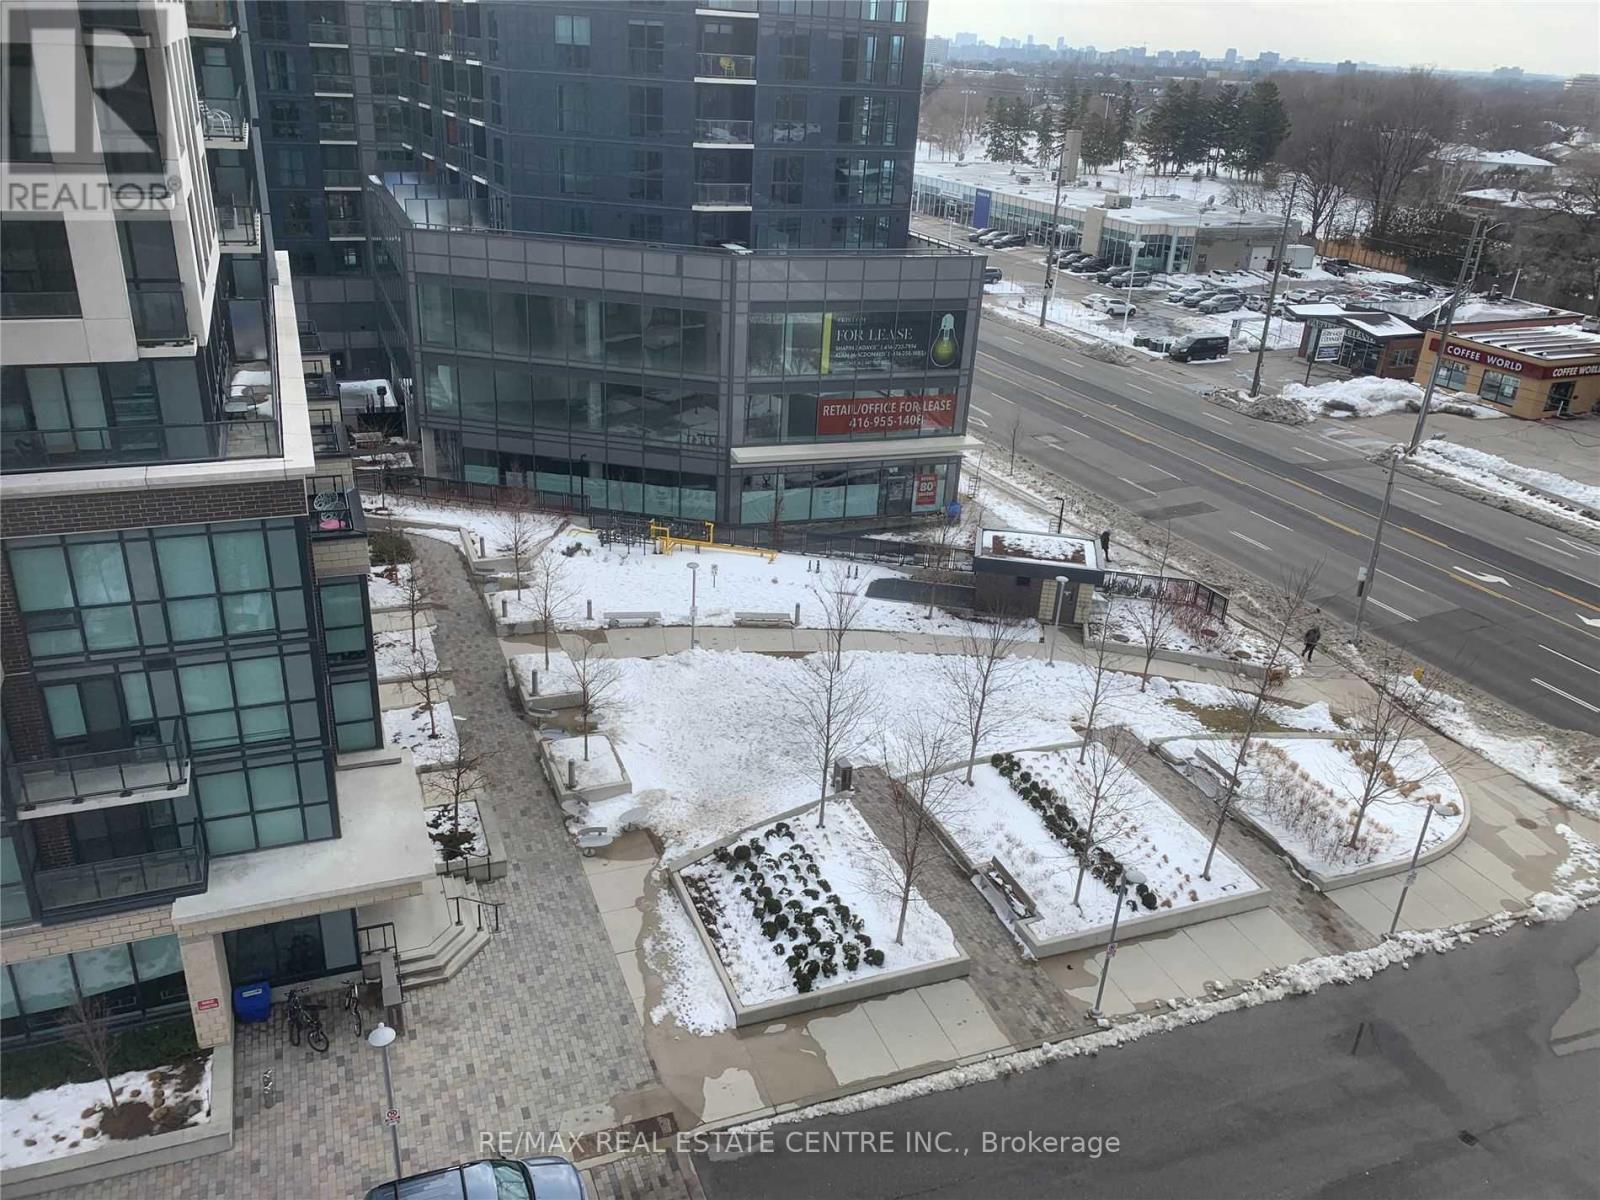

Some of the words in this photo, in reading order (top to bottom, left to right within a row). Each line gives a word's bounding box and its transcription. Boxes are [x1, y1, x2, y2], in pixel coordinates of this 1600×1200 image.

[836, 328, 864, 341] FOR
[869, 327, 913, 341] LEASE
[1447, 345, 1481, 361] COFFEE
[1486, 355, 1523, 372] WORLD
[1552, 366, 1579, 377] COFFEE
[822, 402, 897, 417] RETAIL/OFFICE
[899, 401, 919, 413] FOR
[922, 399, 953, 412] LEASE
